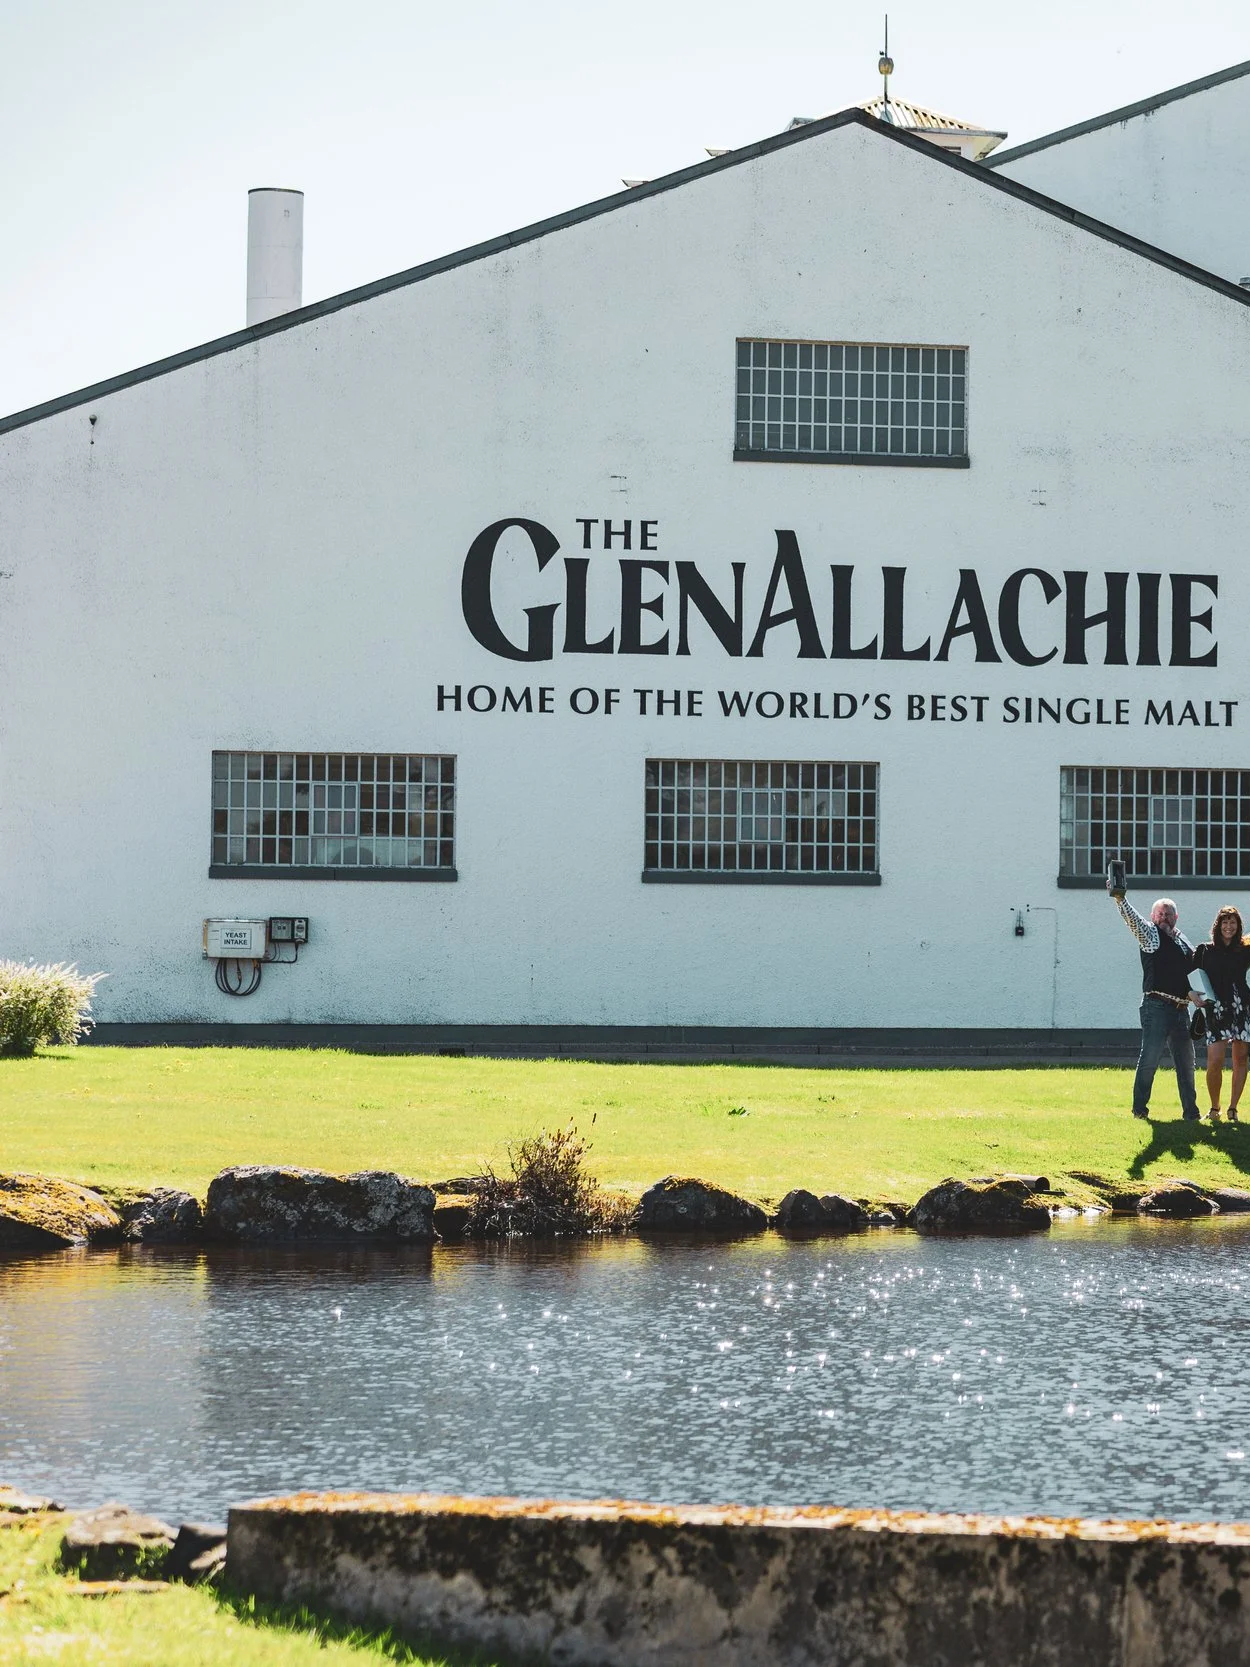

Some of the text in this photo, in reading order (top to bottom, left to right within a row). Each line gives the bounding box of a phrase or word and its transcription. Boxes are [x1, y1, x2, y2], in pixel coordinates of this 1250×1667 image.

[575, 518, 659, 551] THE
[437, 684, 1239, 727] HOME OF THE WORLD'S BEST SINGLE MALT
